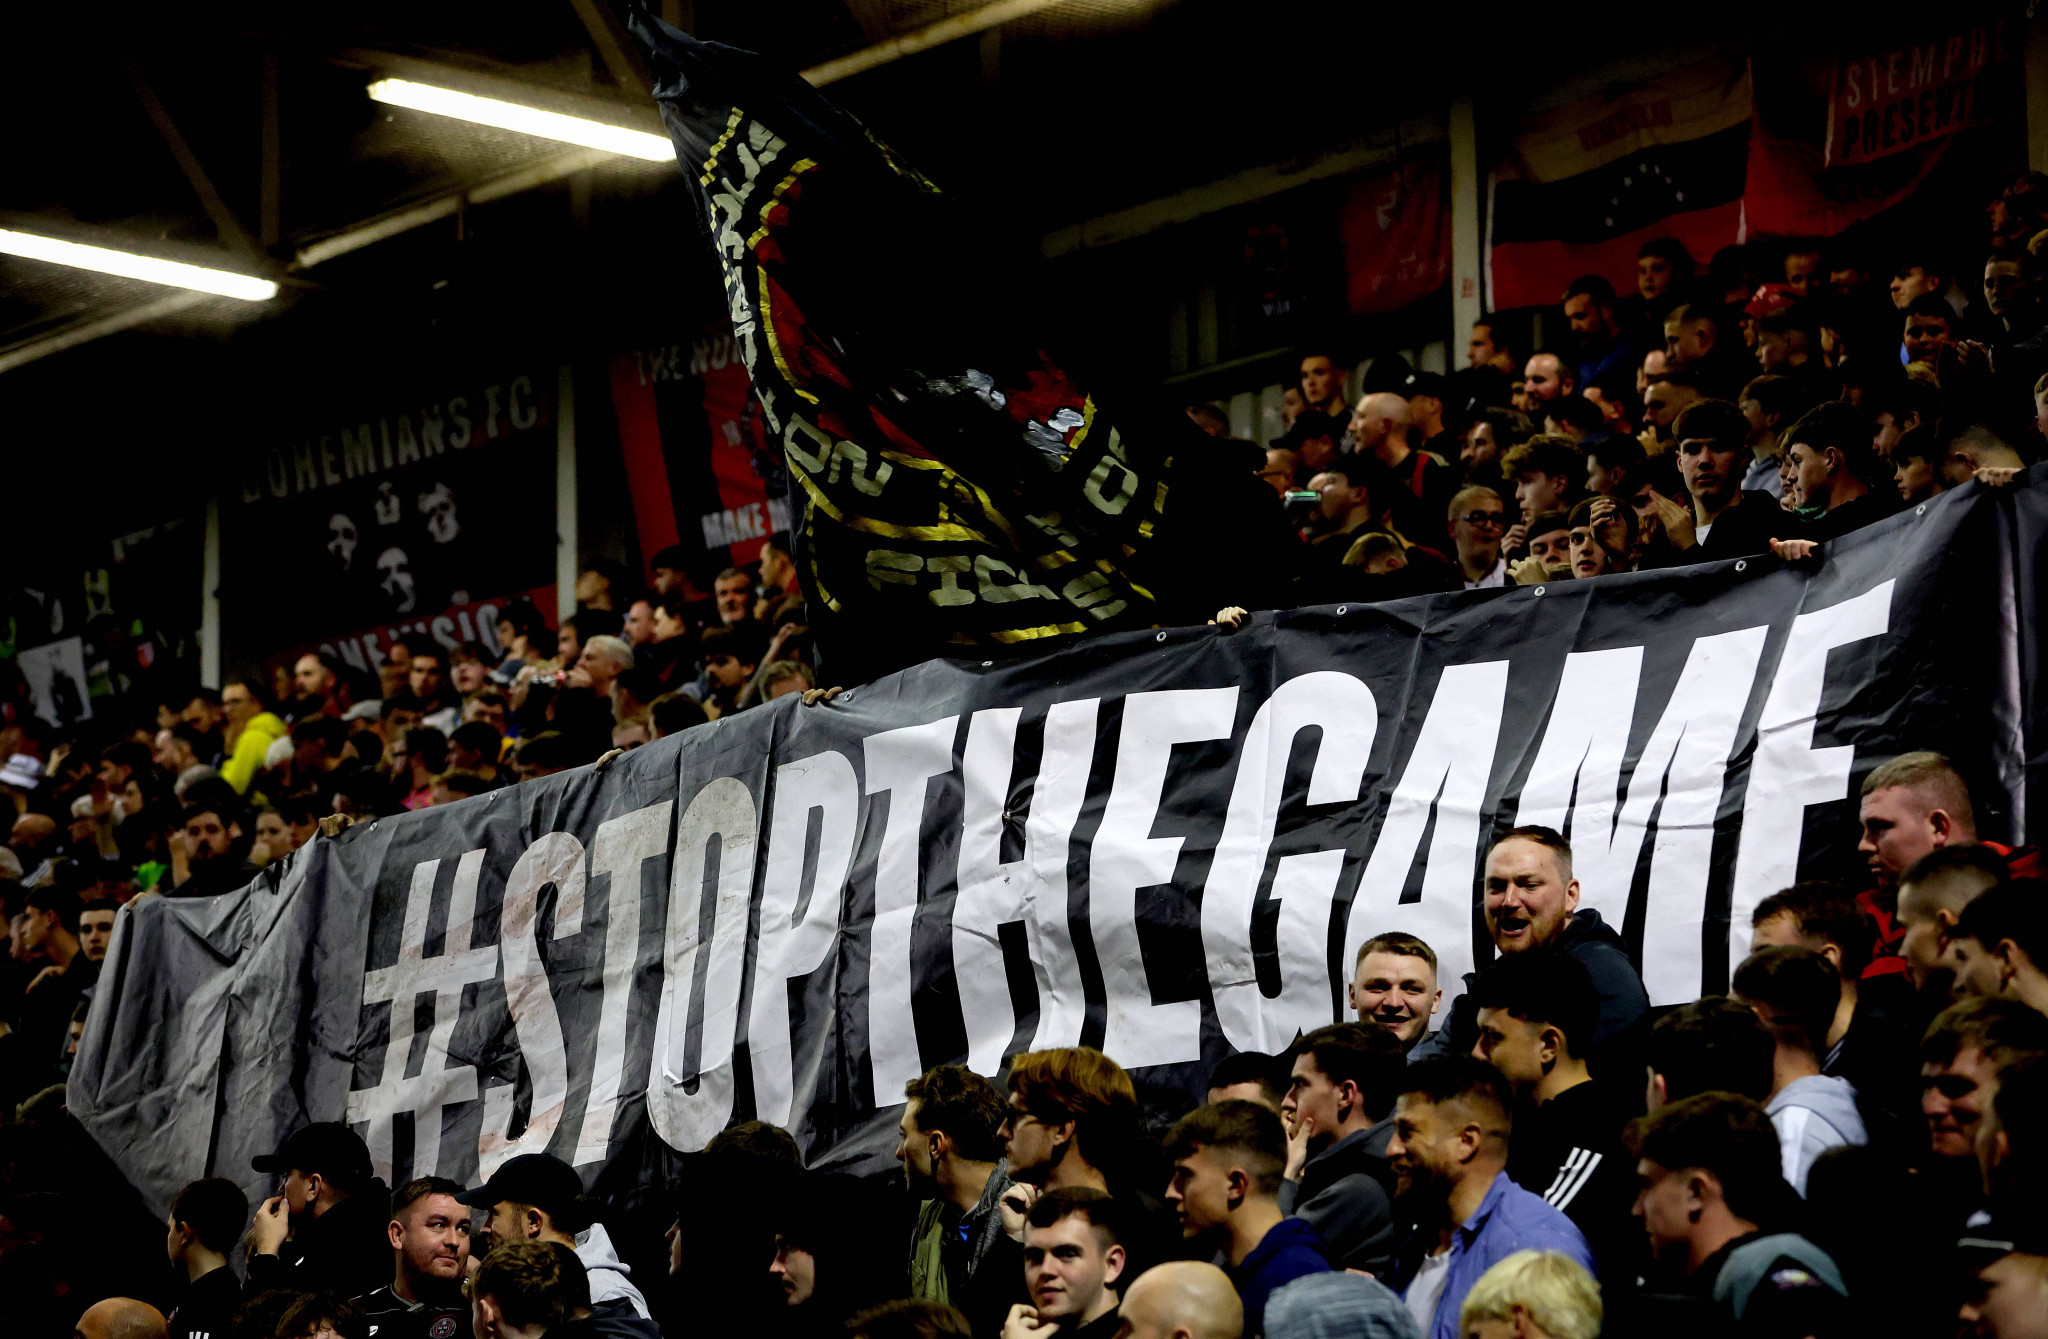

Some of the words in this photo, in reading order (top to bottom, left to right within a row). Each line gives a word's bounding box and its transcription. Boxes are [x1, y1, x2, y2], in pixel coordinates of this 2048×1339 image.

[1844, 17, 2012, 110] SIEMPRE
[632, 344, 685, 387] THE
[241, 395, 473, 504] BOHEMIANS
[484, 375, 539, 440] FC
[701, 502, 767, 551] MAKE
[346, 578, 1896, 1192] #STOPTHEGAME
